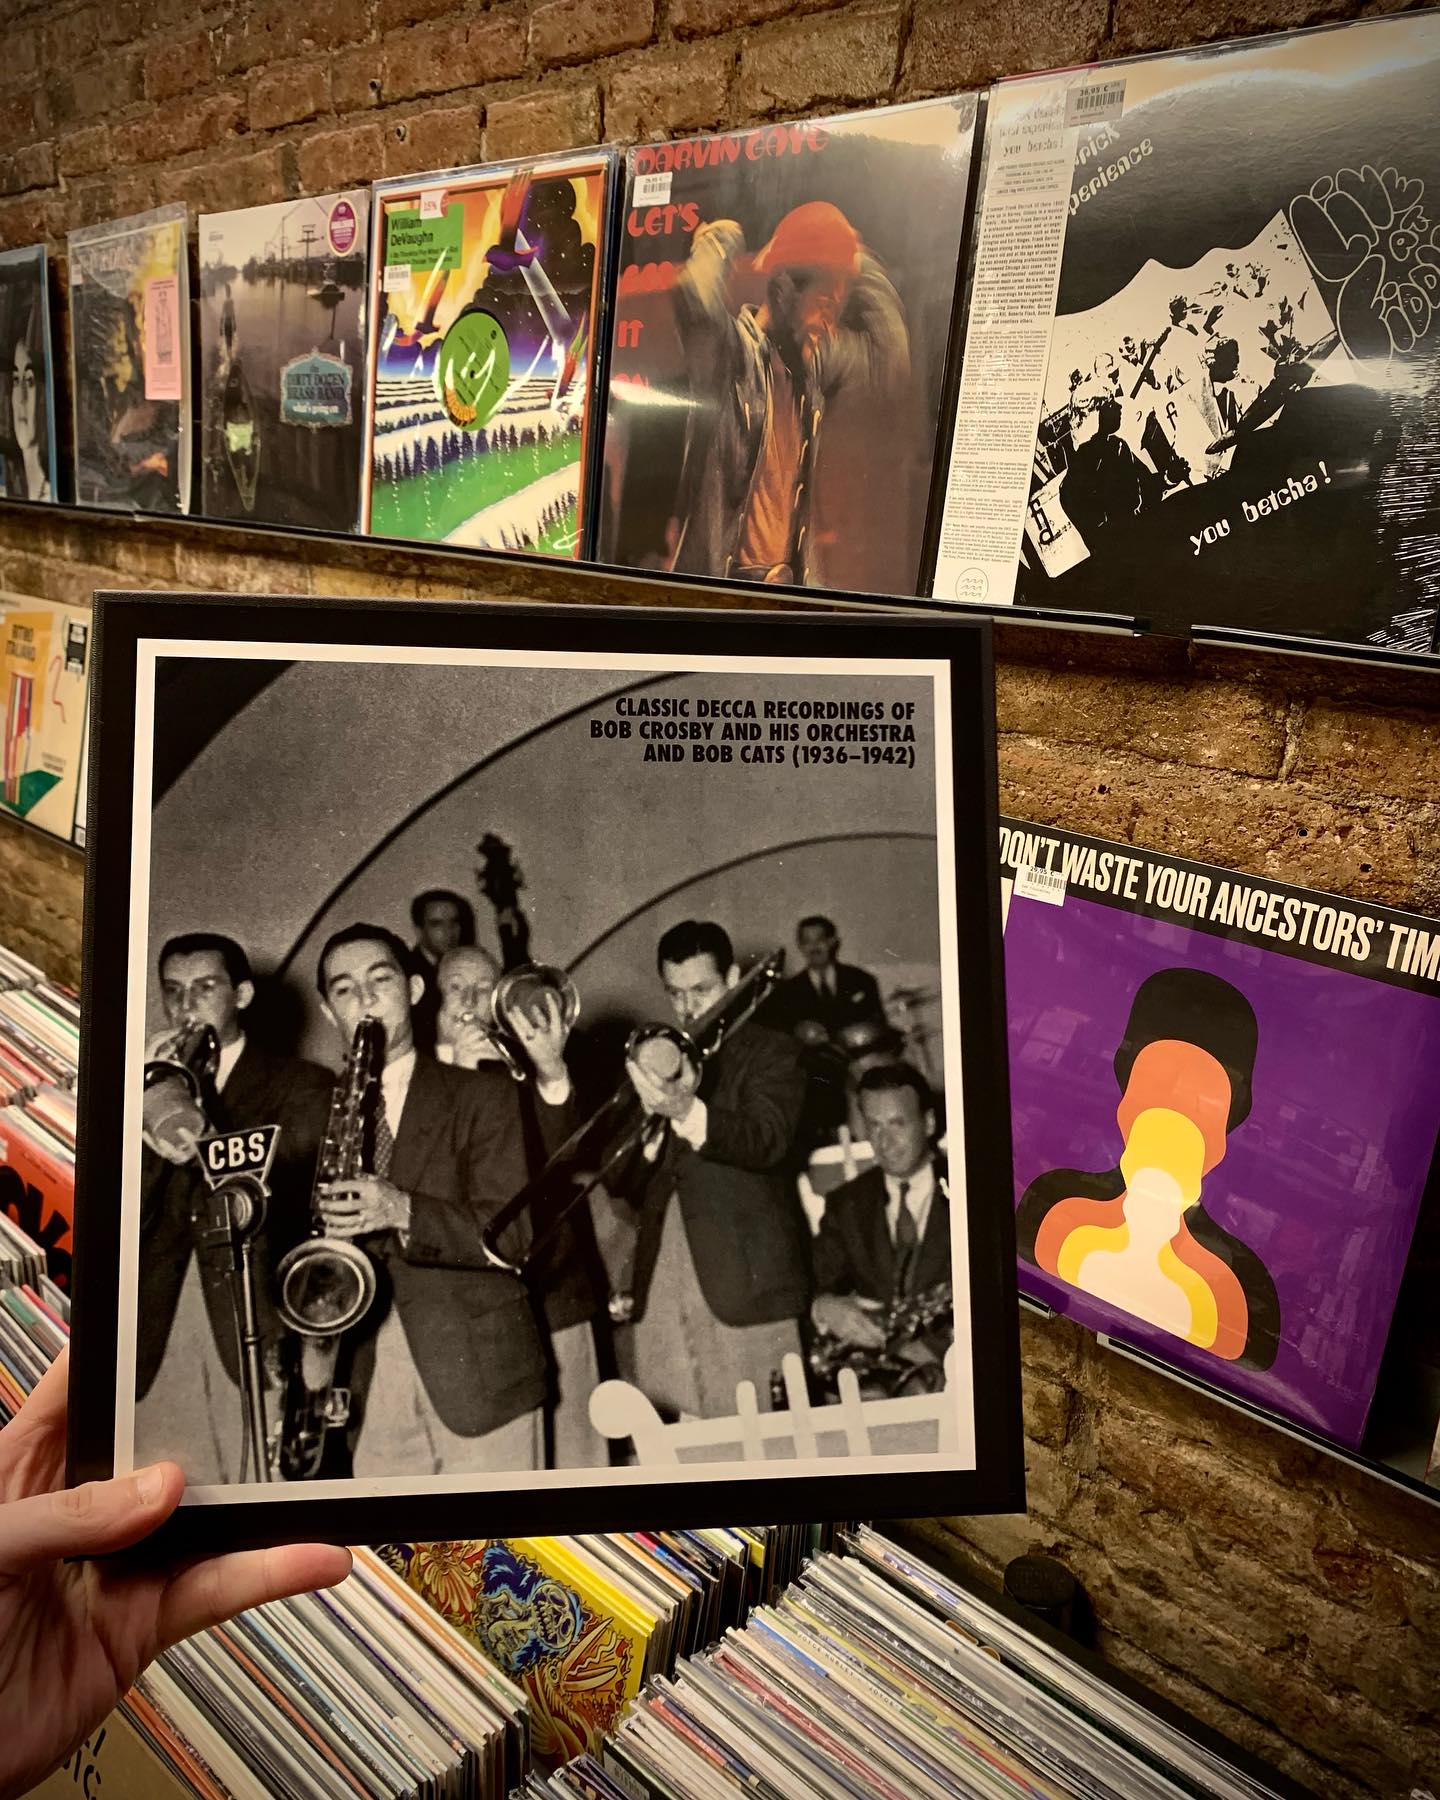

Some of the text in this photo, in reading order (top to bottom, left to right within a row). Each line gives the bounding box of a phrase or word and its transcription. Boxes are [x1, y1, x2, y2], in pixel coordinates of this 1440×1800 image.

[1074, 122, 1121, 166] rick
[391, 231, 433, 247] DeVaughn
[616, 319, 644, 348] IT
[1189, 518, 1231, 556] you
[616, 698, 916, 721] CLASSIC DECCA RECORDINGS OF
[590, 720, 916, 743] BOB CROSBY AND HIS ORCHESTRA
[643, 743, 685, 763] AND
[692, 745, 733, 763] BOB
[740, 745, 786, 764] CATS
[1062, 842, 1145, 901] WASTE
[1144, 862, 1212, 919] YOUR
[1209, 881, 1385, 962] ANCESTORS'
[1386, 923, 1440, 982] TIM
[208, 1131, 266, 1171] CBS
